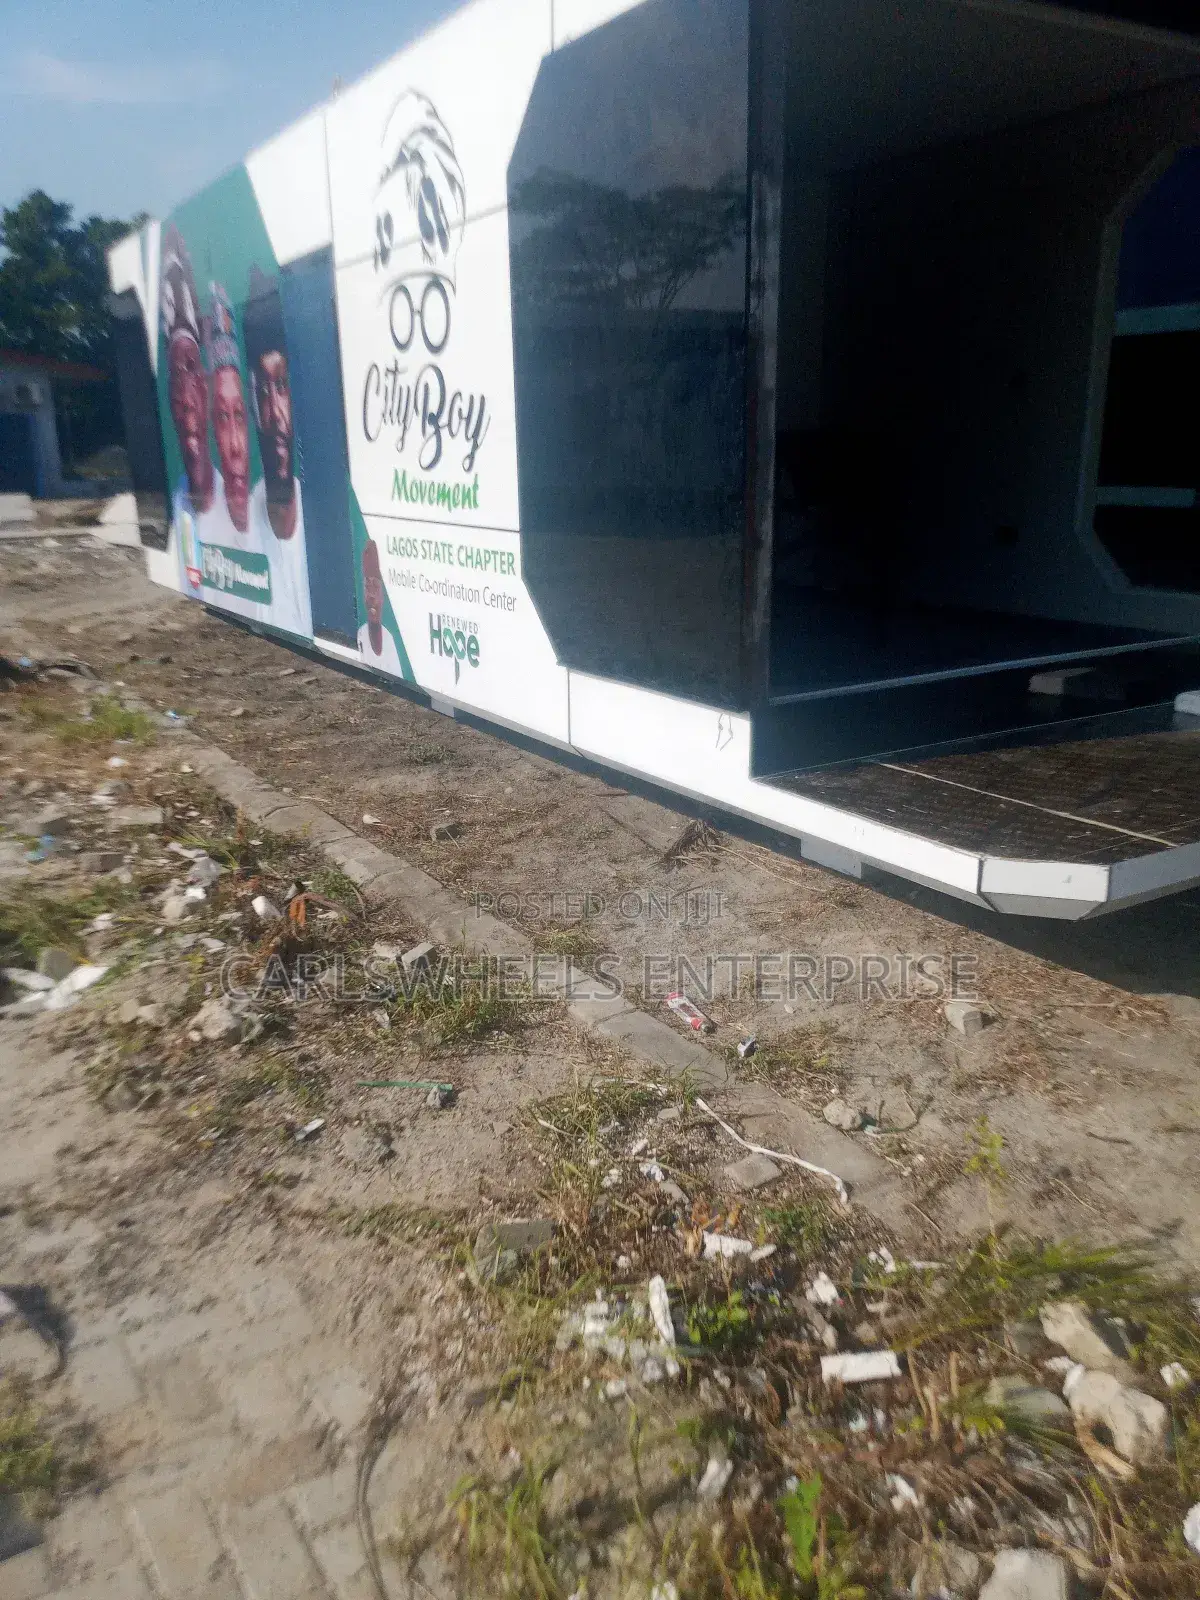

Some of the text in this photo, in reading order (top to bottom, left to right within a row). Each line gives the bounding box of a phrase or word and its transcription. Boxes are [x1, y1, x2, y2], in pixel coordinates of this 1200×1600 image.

[391, 468, 479, 512] Movement
[386, 535, 517, 576] LAGOS STATE CHAPTER
[388, 568, 517, 612] Mobile Co-ordination Center
[441, 614, 480, 635] RENEWED
[428, 612, 481, 685] Hope
